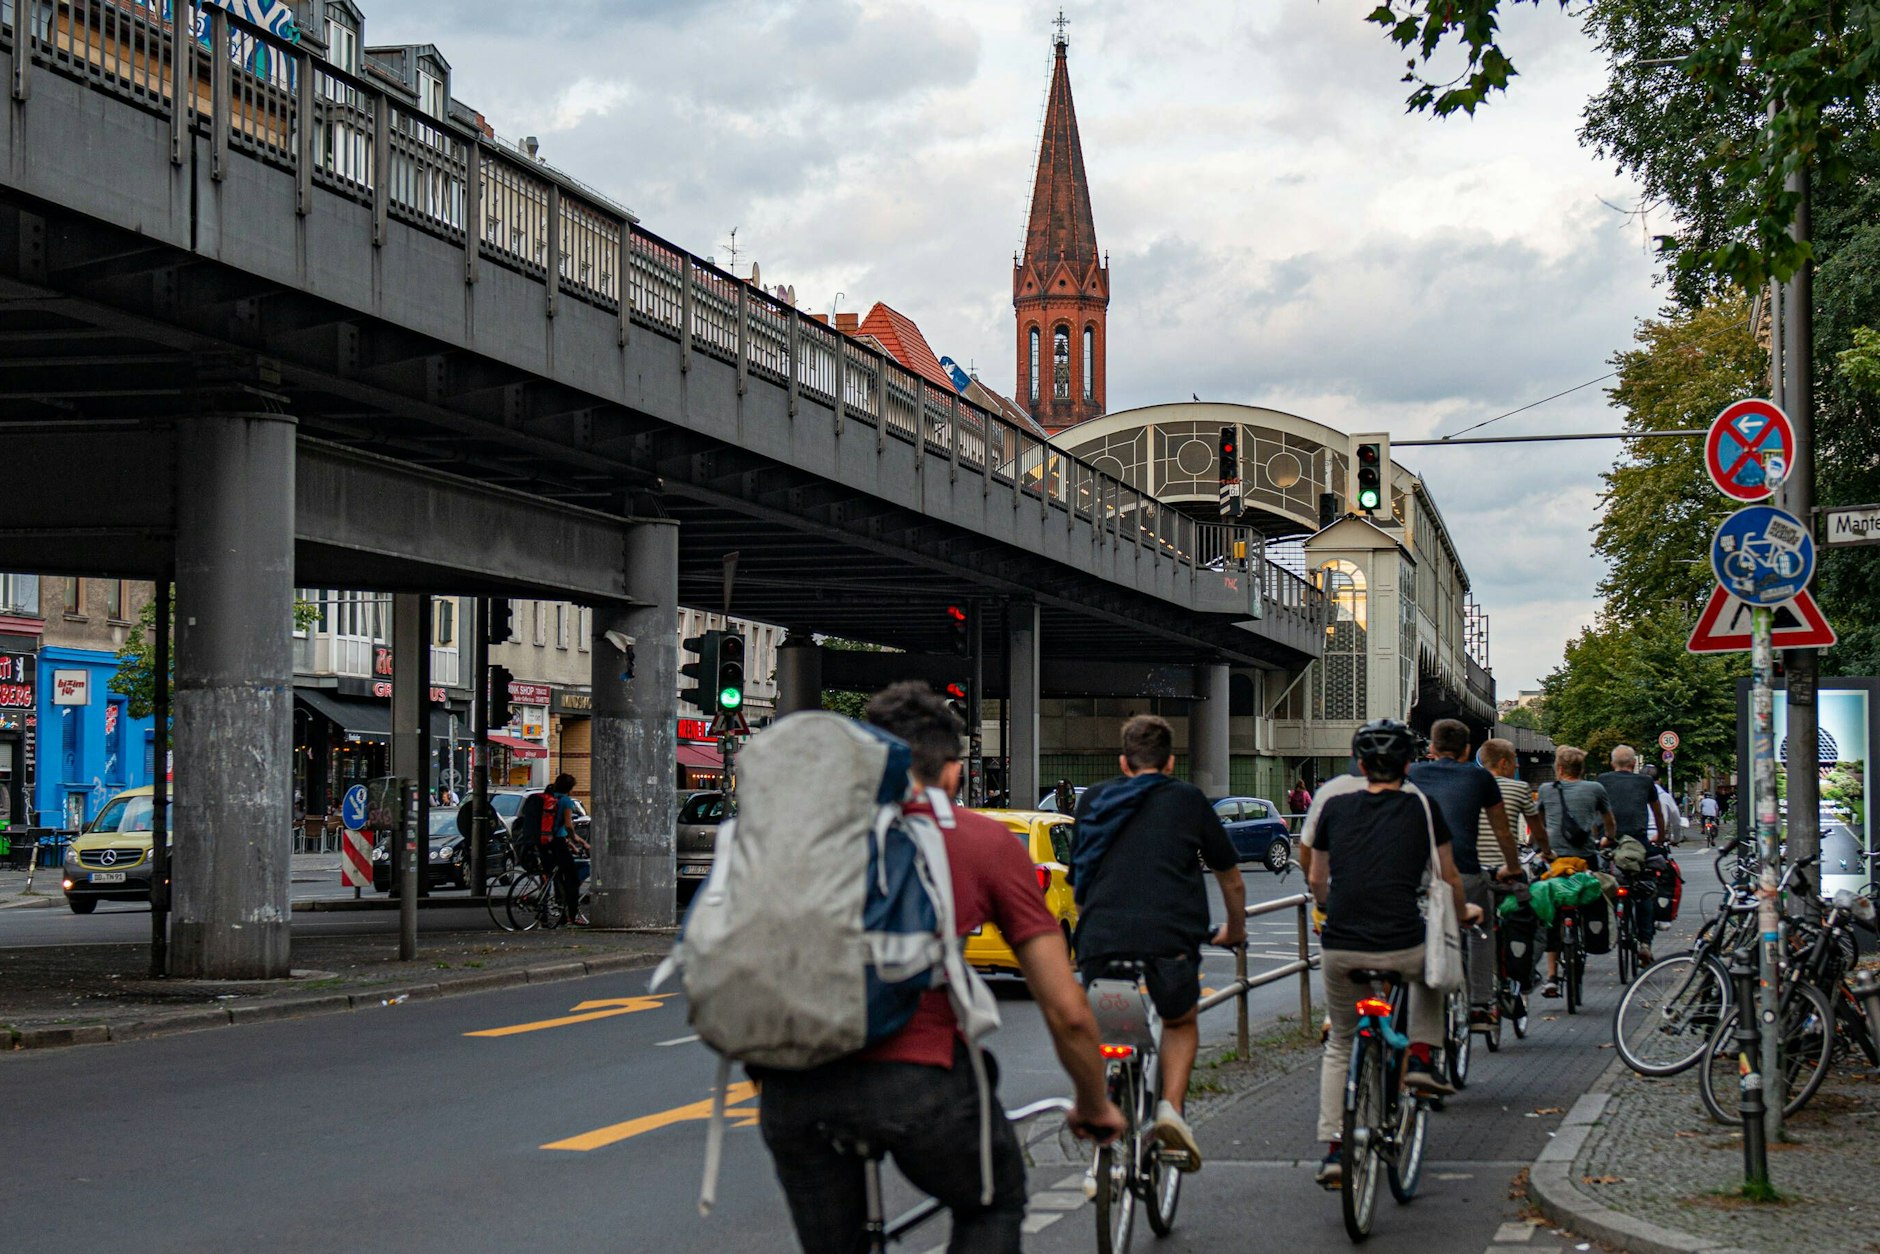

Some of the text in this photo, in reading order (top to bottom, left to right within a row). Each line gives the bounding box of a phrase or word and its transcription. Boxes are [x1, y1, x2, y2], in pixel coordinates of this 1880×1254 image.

[1835, 514, 1880, 534] Mante
[57, 678, 85, 688] bizim
[520, 685, 534, 695] SHOP
[1663, 737, 1675, 745] 30
